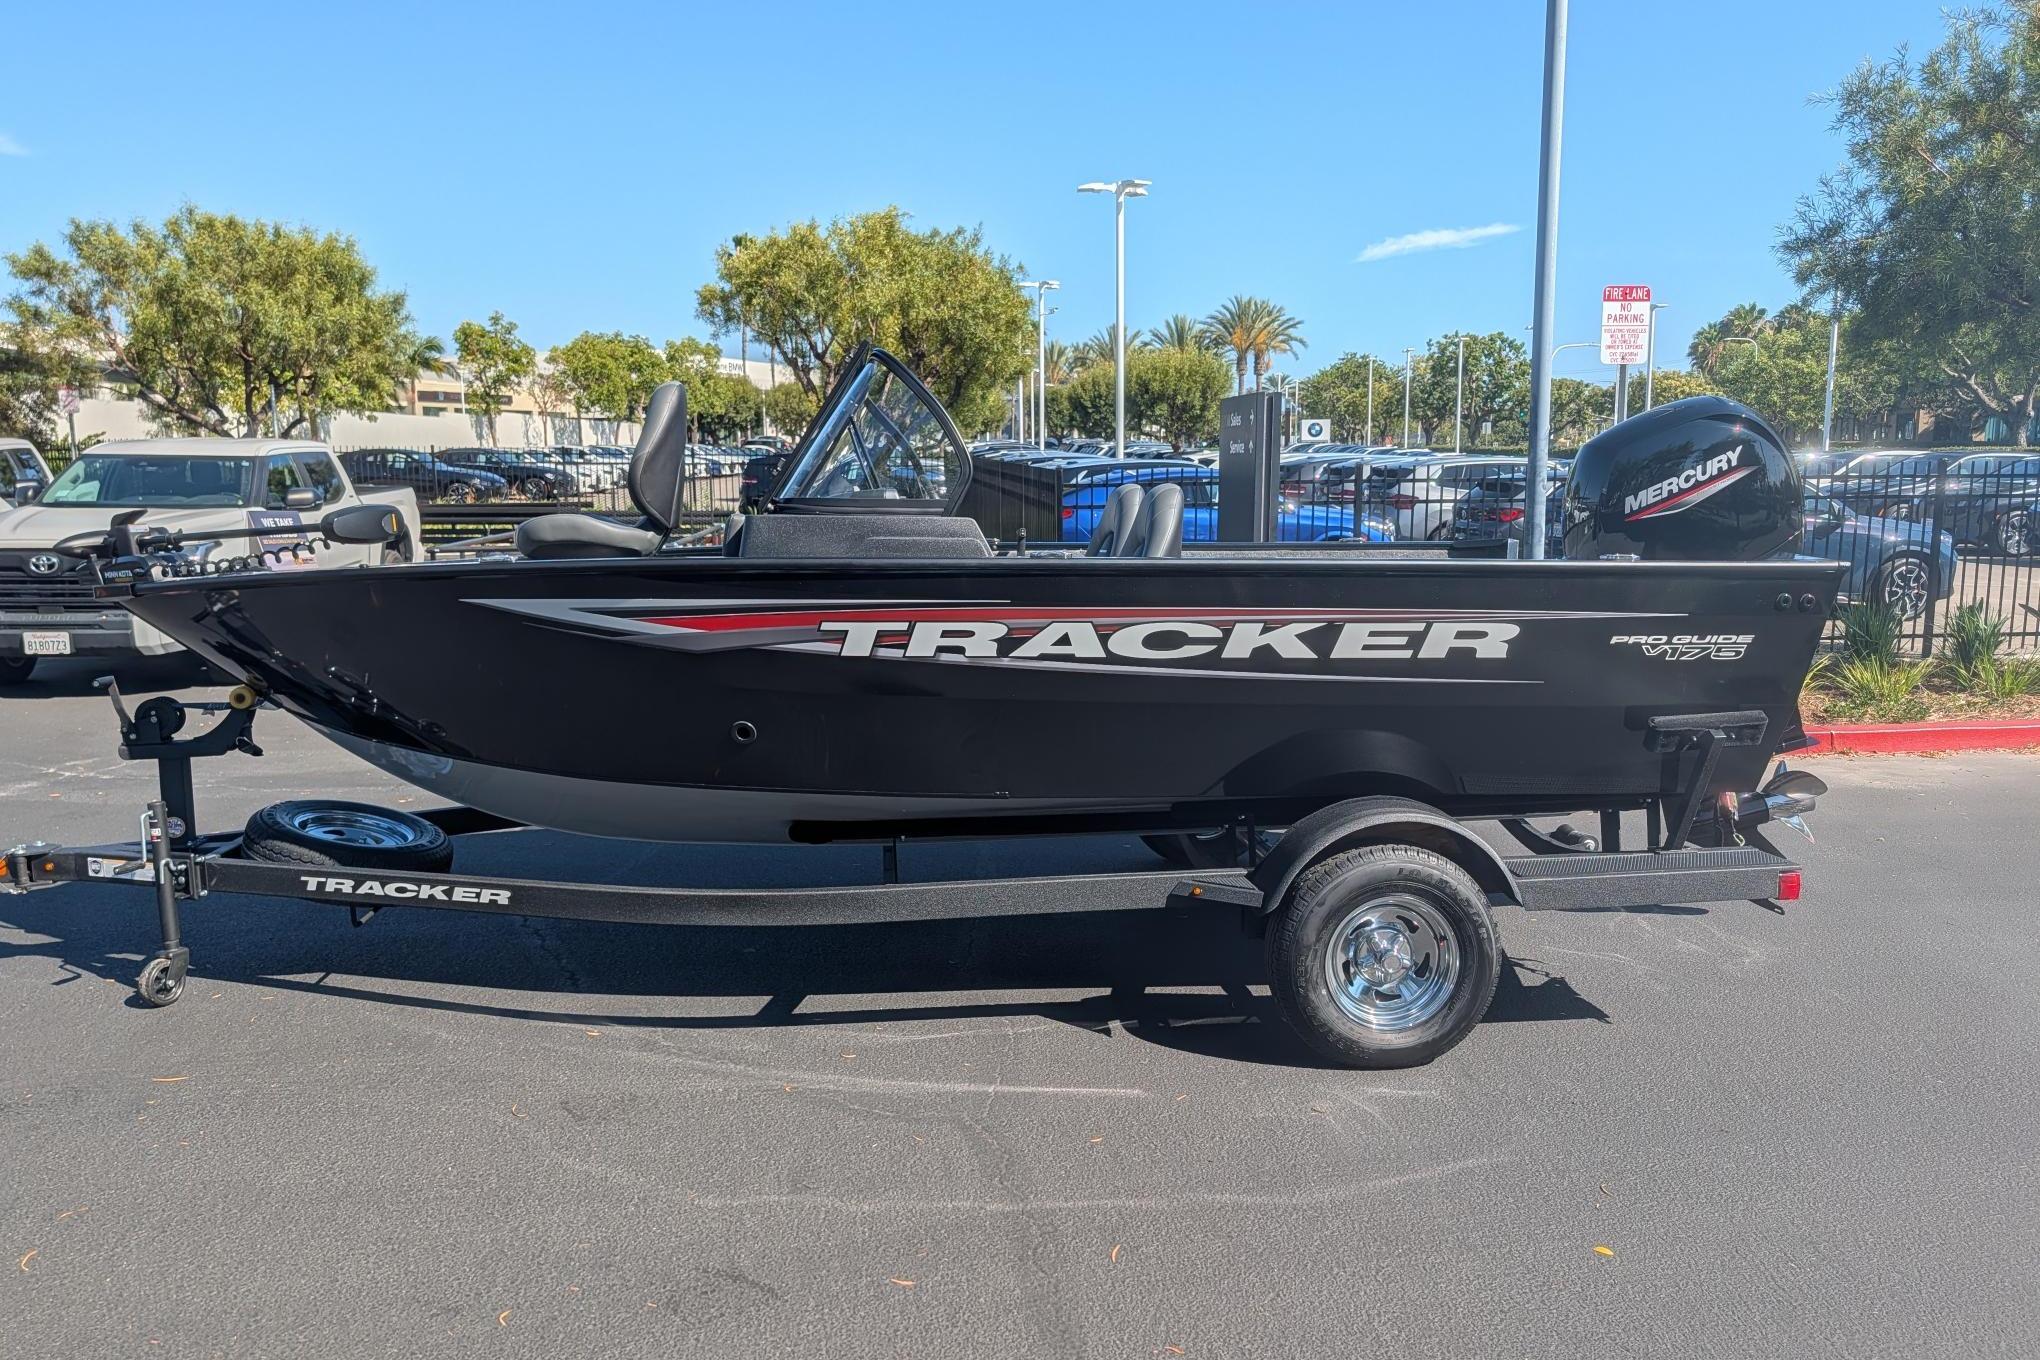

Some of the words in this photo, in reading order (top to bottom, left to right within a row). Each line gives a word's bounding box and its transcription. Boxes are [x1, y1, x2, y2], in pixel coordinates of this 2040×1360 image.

[1605, 287, 1624, 300] FIRE
[1627, 287, 1649, 300] LANE
[1620, 302, 1632, 312] NO
[1607, 313, 1645, 323] PARKING
[1231, 413, 1241, 427] Sales
[1230, 440, 1244, 454] Service
[1624, 445, 1743, 515] MERCURY
[261, 517, 275, 527] WE
[275, 517, 294, 527] TAKE
[119, 569, 133, 577] KOTA
[27, 640, 67, 651] 81807Z3
[817, 621, 1520, 660] TRACKER
[1610, 635, 1668, 644] PRO
[1672, 634, 1756, 644] GUIDE
[1642, 644, 1748, 660] V175
[300, 876, 512, 905] TRACKER
